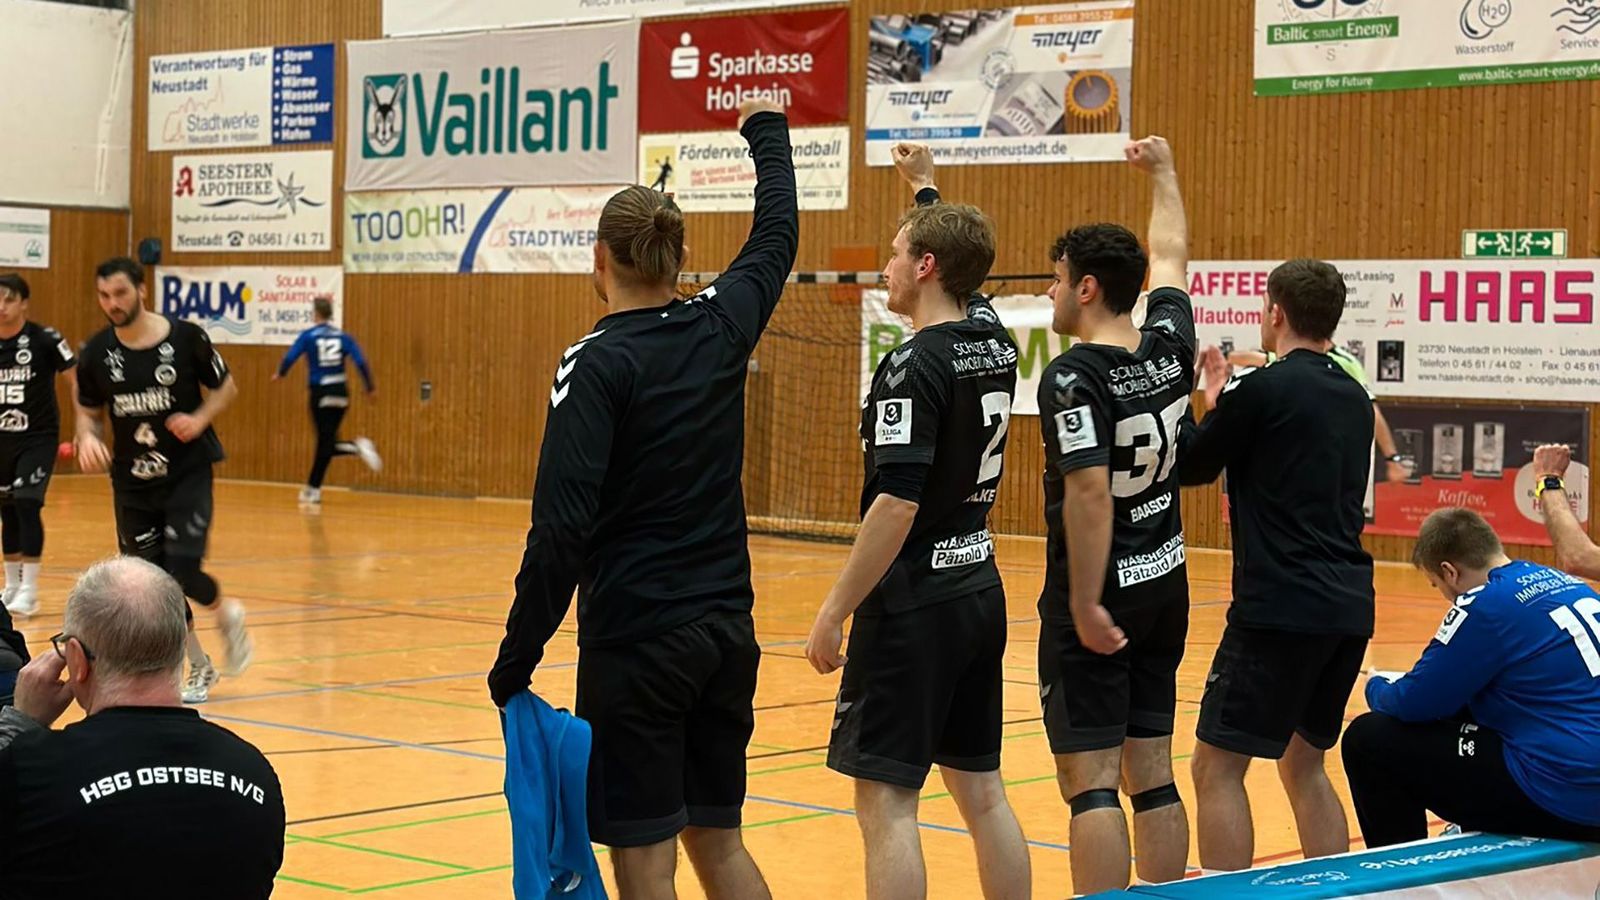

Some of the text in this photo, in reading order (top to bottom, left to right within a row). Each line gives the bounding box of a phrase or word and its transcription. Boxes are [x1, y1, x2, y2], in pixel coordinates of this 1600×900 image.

[1273, 22, 1392, 42] Baltic smart Energy
[1455, 41, 1515, 55] Wasserstoff
[1560, 38, 1599, 50] Service
[152, 52, 267, 74] Verantwortung für
[708, 49, 813, 83] Sparkasse
[1458, 63, 1600, 82] www.baltic-smart-energy.d
[152, 77, 208, 95] Neustadt
[1292, 76, 1374, 92] Energy for Future
[413, 61, 619, 157] Vaillant
[186, 112, 260, 132] Stadtwerke
[198, 162, 273, 180] SEESTERN
[198, 181, 273, 197] APOTHEKE
[351, 203, 466, 244] TOOOHR!
[177, 234, 222, 247] Neustadt
[249, 232, 282, 246] 04561
[162, 275, 246, 321] BAUM
[316, 337, 342, 367] 12
[1417, 345, 1446, 354] 23730
[1449, 345, 1490, 354] Neustadt
[1493, 345, 1500, 354] in
[1503, 346, 1543, 356] Holstein
[1418, 358, 1450, 368] Telefon
[1542, 360, 1559, 370] Fax
[977, 391, 1011, 485] 2
[1438, 488, 1488, 507] Kaffee,
[935, 549, 982, 567] Pätzold
[1123, 557, 1170, 585] Pätzold
[80, 766, 265, 805] HSG OSTSEE N/G
